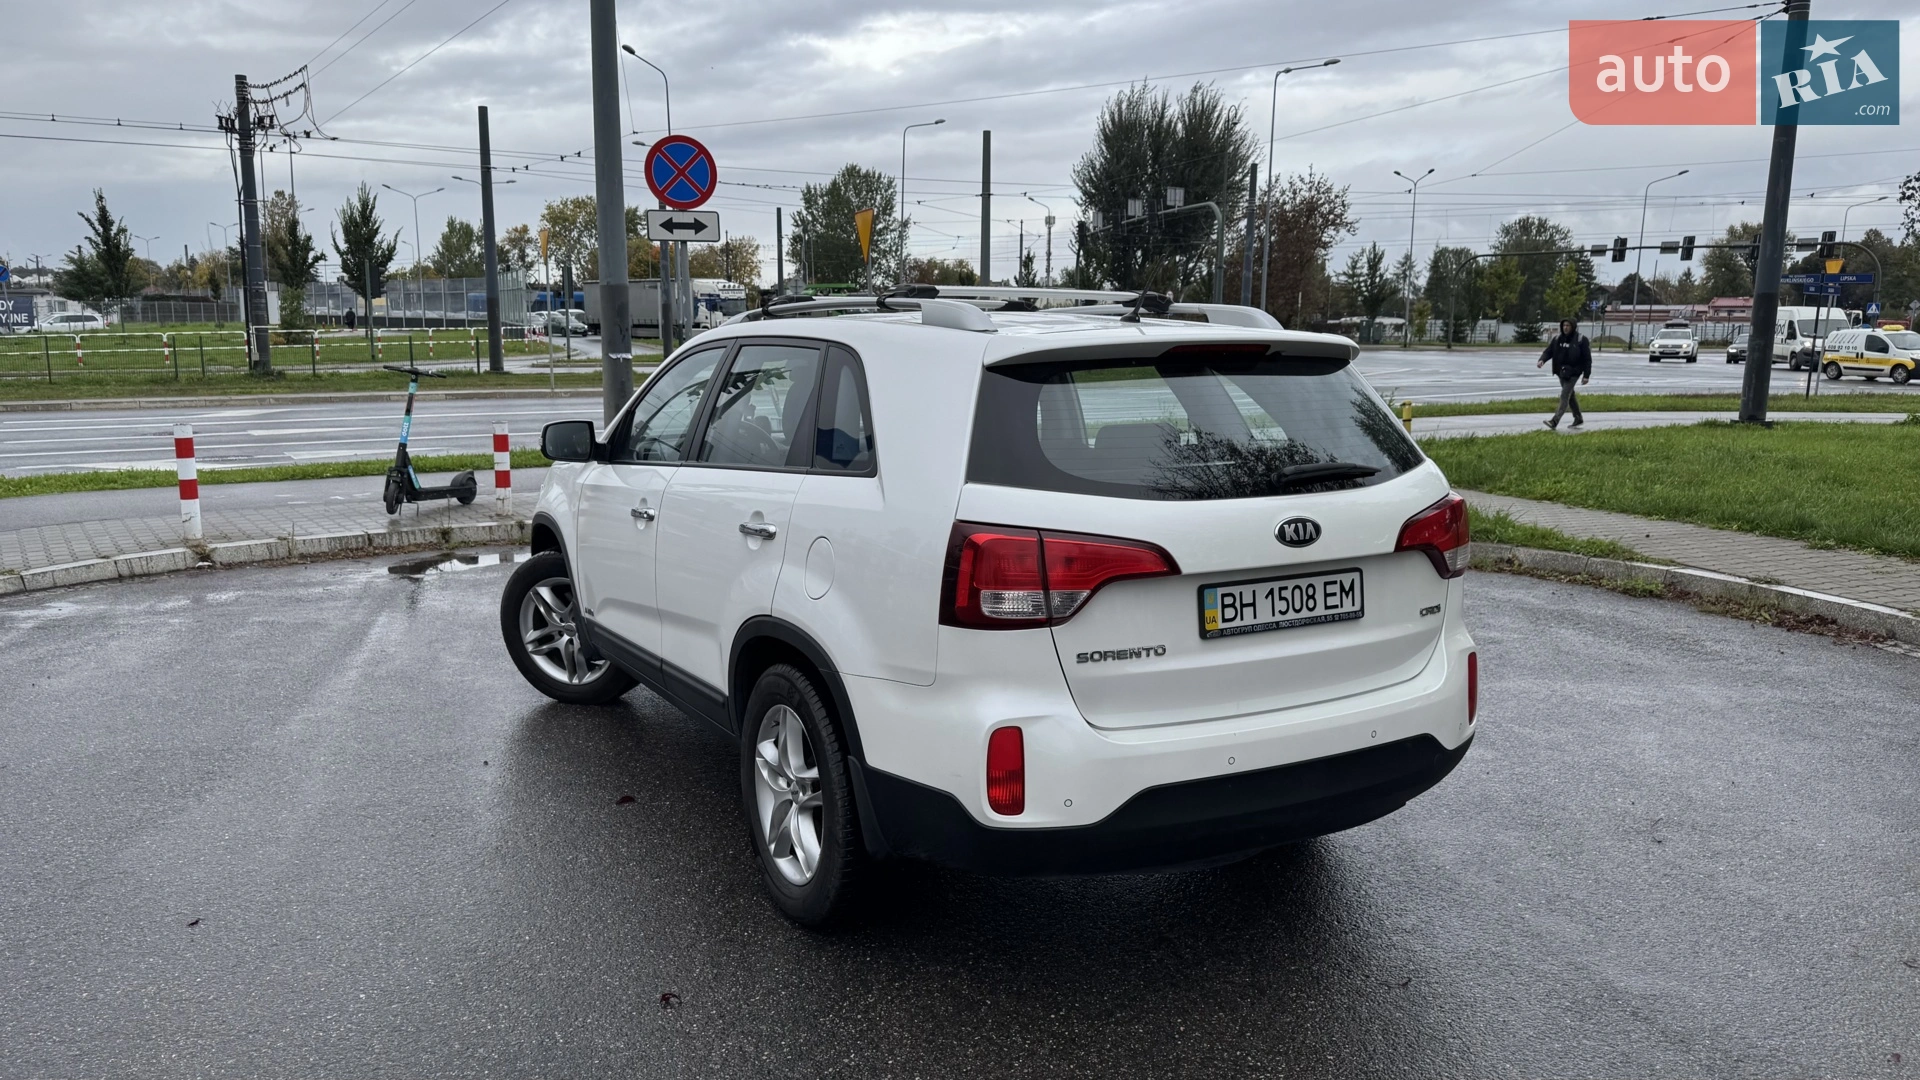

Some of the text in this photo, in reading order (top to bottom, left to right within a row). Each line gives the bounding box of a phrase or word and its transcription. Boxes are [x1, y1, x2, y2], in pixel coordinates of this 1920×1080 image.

[1283, 522, 1317, 541] KIA
[1264, 583, 1317, 616] 1508
[1205, 615, 1217, 625] UA
[1076, 644, 1167, 664] SORENTO
